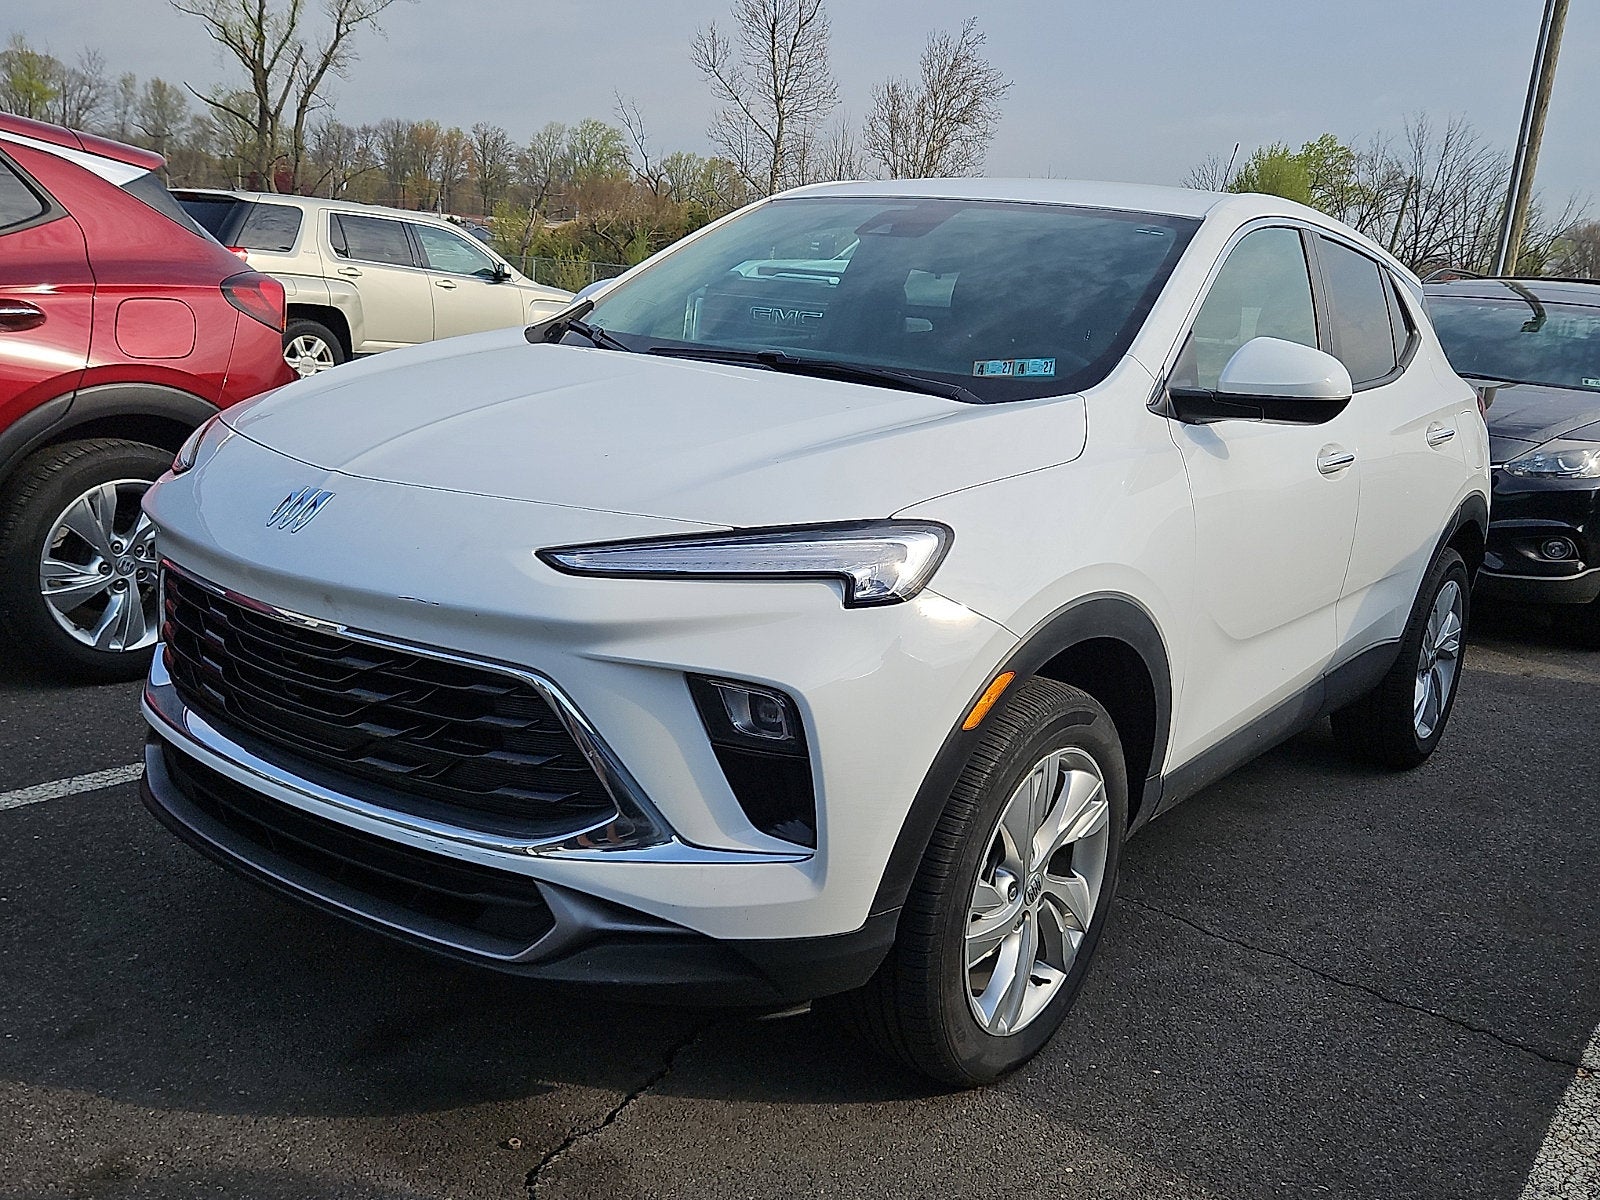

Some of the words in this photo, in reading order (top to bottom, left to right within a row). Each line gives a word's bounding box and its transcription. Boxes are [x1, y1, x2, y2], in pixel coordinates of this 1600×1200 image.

[750, 306, 823, 326] GMC
[977, 364, 984, 375] 4
[1002, 361, 1012, 374] 27
[1018, 363, 1025, 374] 4
[1043, 361, 1053, 373] 27
